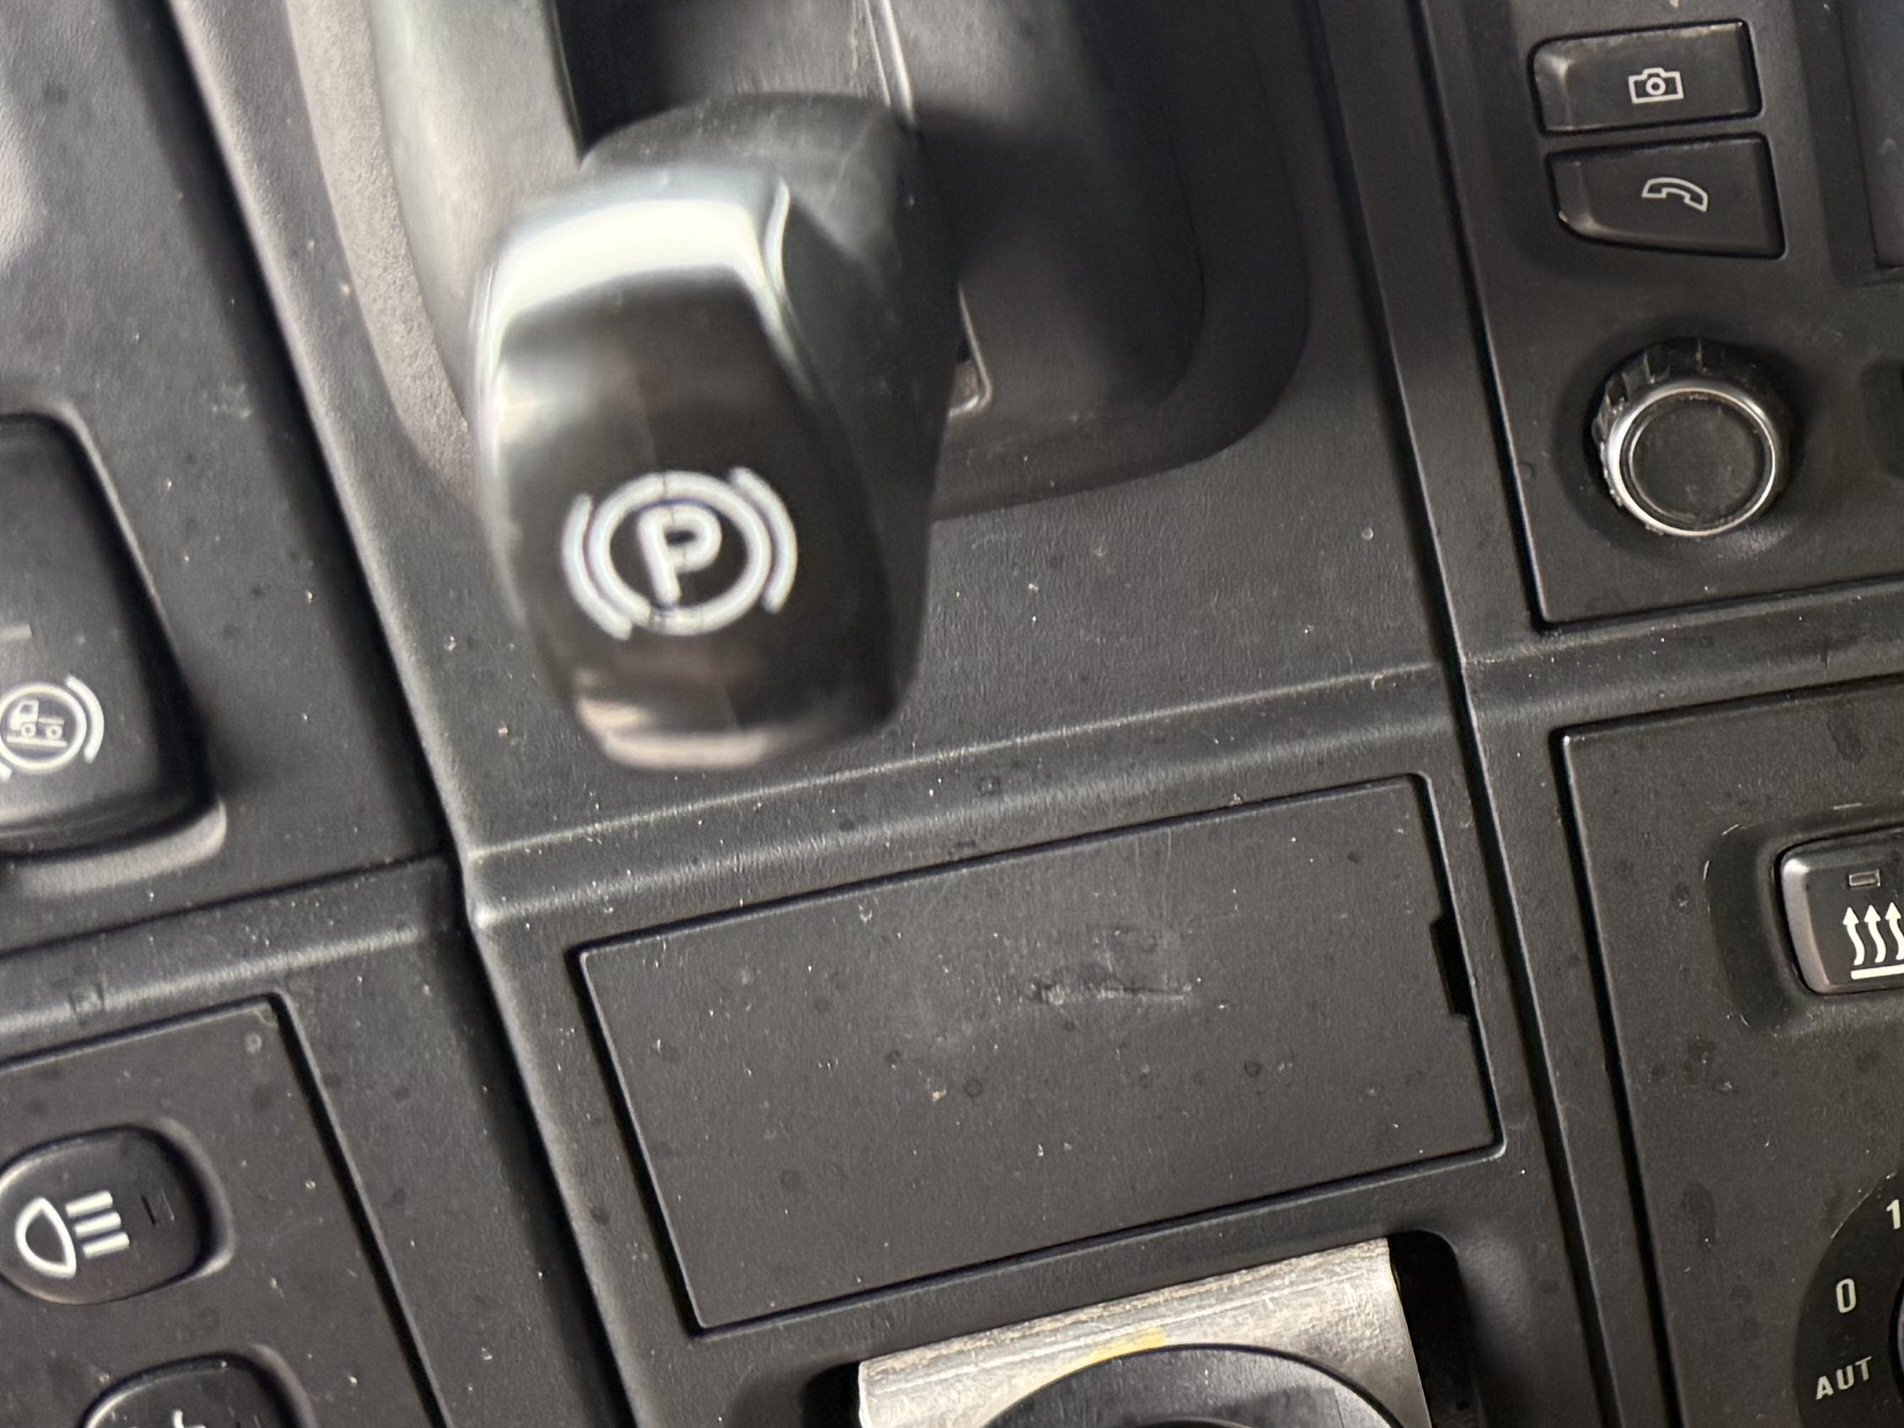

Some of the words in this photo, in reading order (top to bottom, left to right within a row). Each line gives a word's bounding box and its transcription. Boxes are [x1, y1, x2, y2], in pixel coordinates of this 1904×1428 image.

[1886, 1199, 1901, 1230] 1
[1835, 1278, 1857, 1314] 0
[1816, 1356, 1872, 1400] AUT
